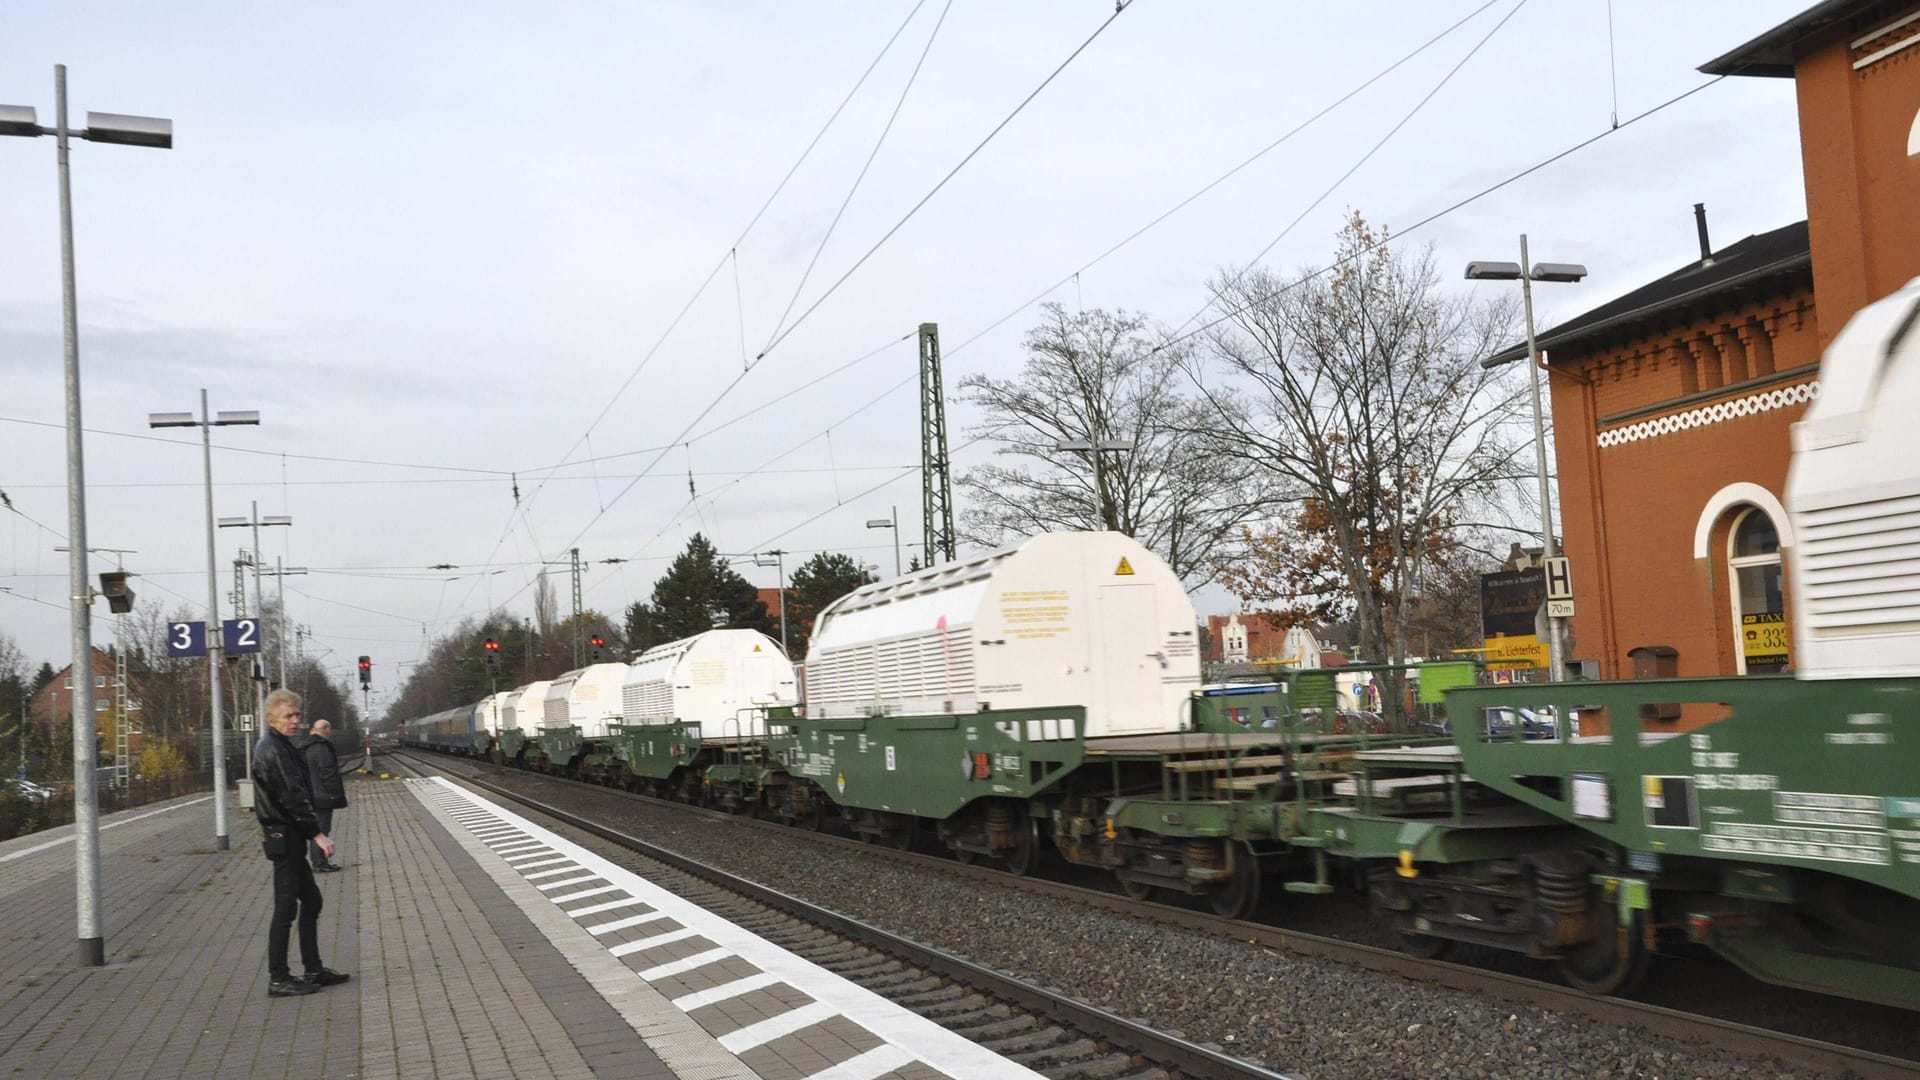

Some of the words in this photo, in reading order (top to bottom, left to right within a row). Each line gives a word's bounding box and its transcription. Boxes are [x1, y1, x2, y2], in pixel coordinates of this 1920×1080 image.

[1548, 561, 1569, 594] H
[1551, 603, 1563, 614] 70
[172, 623, 192, 649] 3
[237, 620, 257, 645] 2
[1506, 644, 1541, 656] Lichterfest
[242, 716, 252, 729] H
